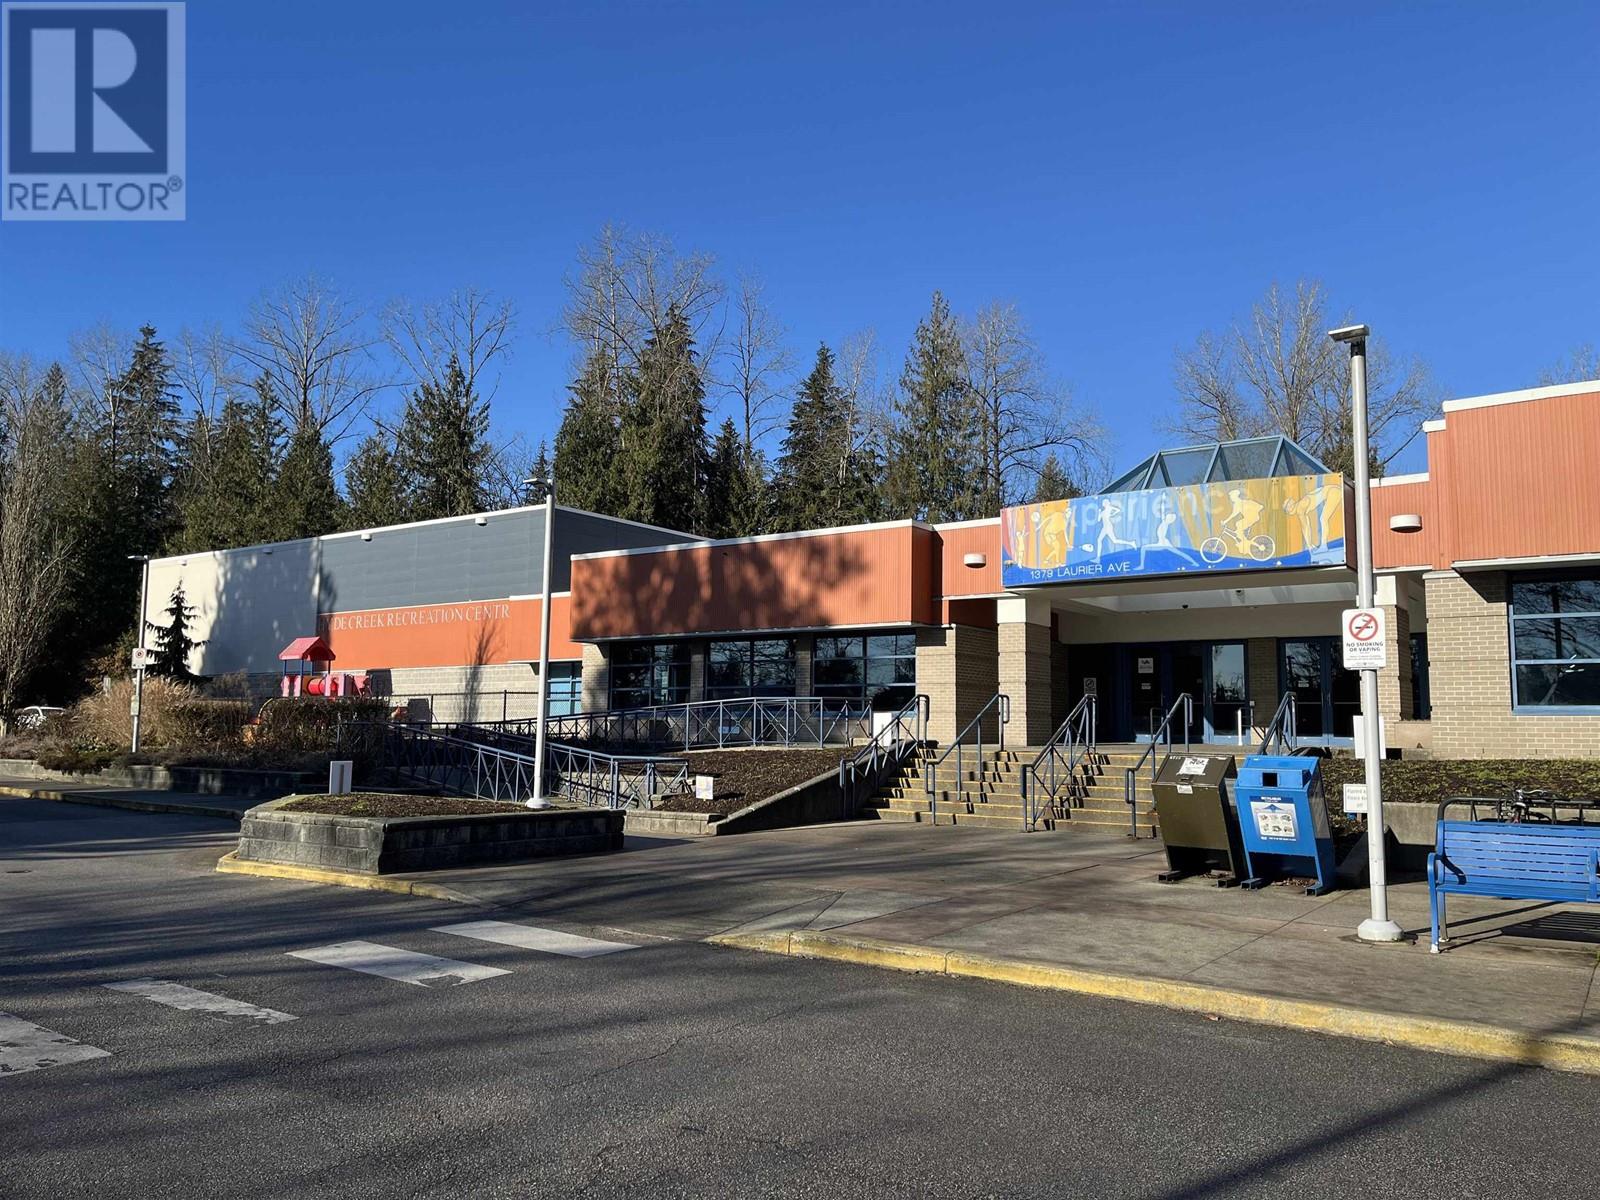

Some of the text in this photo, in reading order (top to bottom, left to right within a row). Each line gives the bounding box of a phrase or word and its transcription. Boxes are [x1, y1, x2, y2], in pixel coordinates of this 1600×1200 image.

[1057, 563, 1103, 577] LAURIER
[1107, 561, 1131, 573] AVE
[348, 613, 386, 629] CREEK
[387, 608, 463, 627] RECREATION
[464, 604, 510, 621] CENTR
